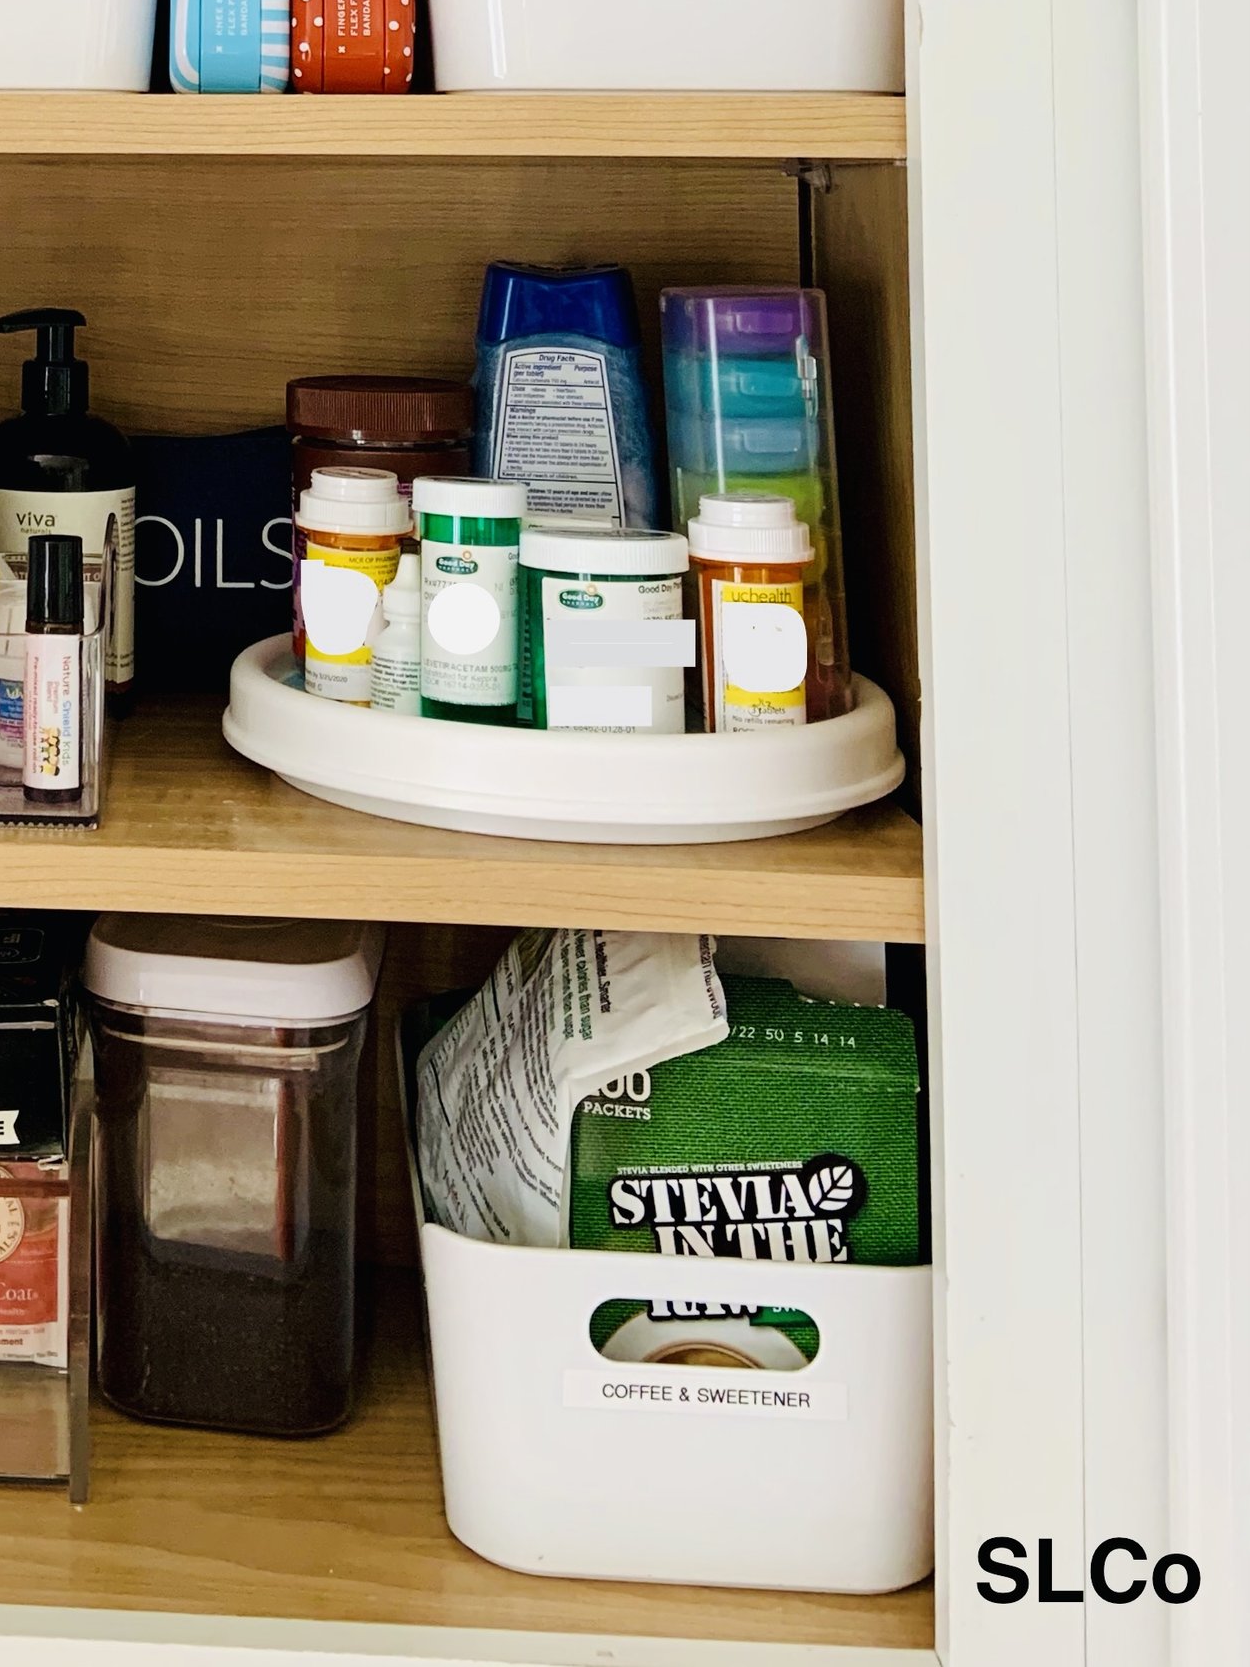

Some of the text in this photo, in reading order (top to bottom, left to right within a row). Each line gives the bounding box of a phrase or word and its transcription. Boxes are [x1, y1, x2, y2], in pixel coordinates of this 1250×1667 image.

[350, 10, 358, 37] FLEX
[539, 355, 555, 363] Drug
[509, 407, 536, 415] Warnings
[16, 511, 56, 527] viva
[135, 515, 293, 589] OILS
[638, 584, 660, 594] Good
[731, 588, 791, 603] uchealth
[562, 592, 599, 605] Good Day
[62, 656, 71, 696] Nature
[764, 717, 795, 726] remaining
[765, 1028, 856, 1049] 50 5 14 14
[583, 1100, 651, 1121] PACKETS
[617, 1161, 803, 1175] STEVIA BLENDED WITH OTHER SWEETENERS
[611, 1174, 815, 1225] STEVIA
[655, 1219, 848, 1263] IN THE
[602, 1384, 811, 1409] COFFEE & SWEETENER
